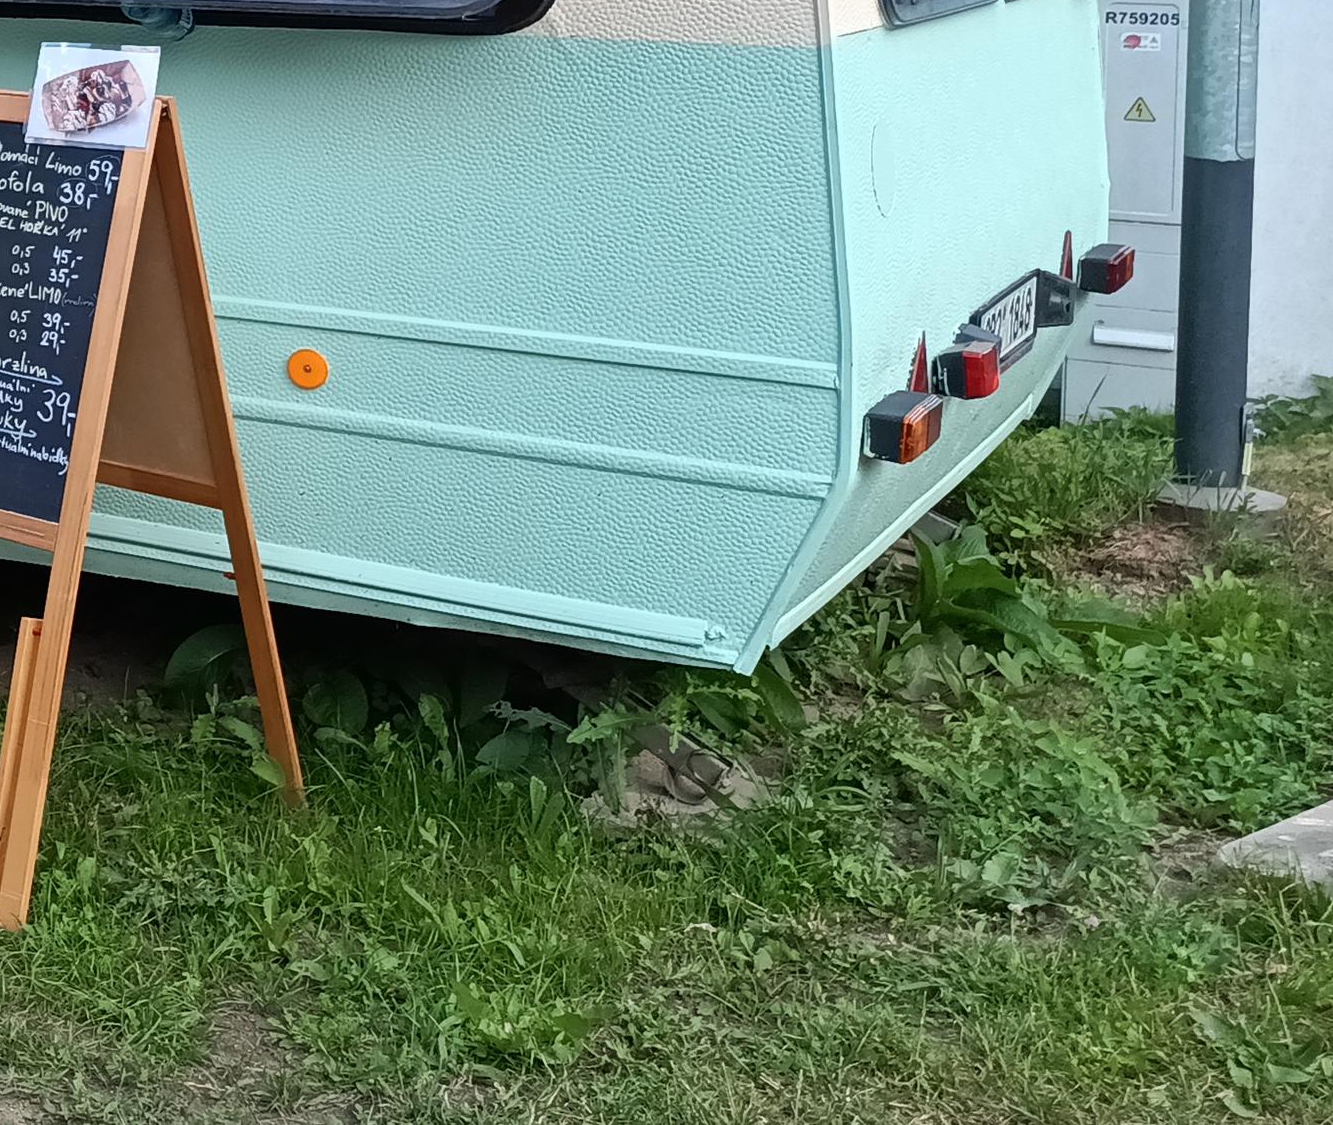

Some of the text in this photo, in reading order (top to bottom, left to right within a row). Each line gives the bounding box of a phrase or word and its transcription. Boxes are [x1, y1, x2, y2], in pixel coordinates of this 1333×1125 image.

[1105, 11, 1180, 26] R759205
[45, 151, 82, 176] Limo
[35, 201, 68, 222] PIVO
[11, 245, 35, 258] 0,5
[11, 262, 30, 275] 0,3
[29, 281, 62, 305] LIMO
[10, 310, 31, 324] 0,5
[9, 329, 27, 343] 0,3
